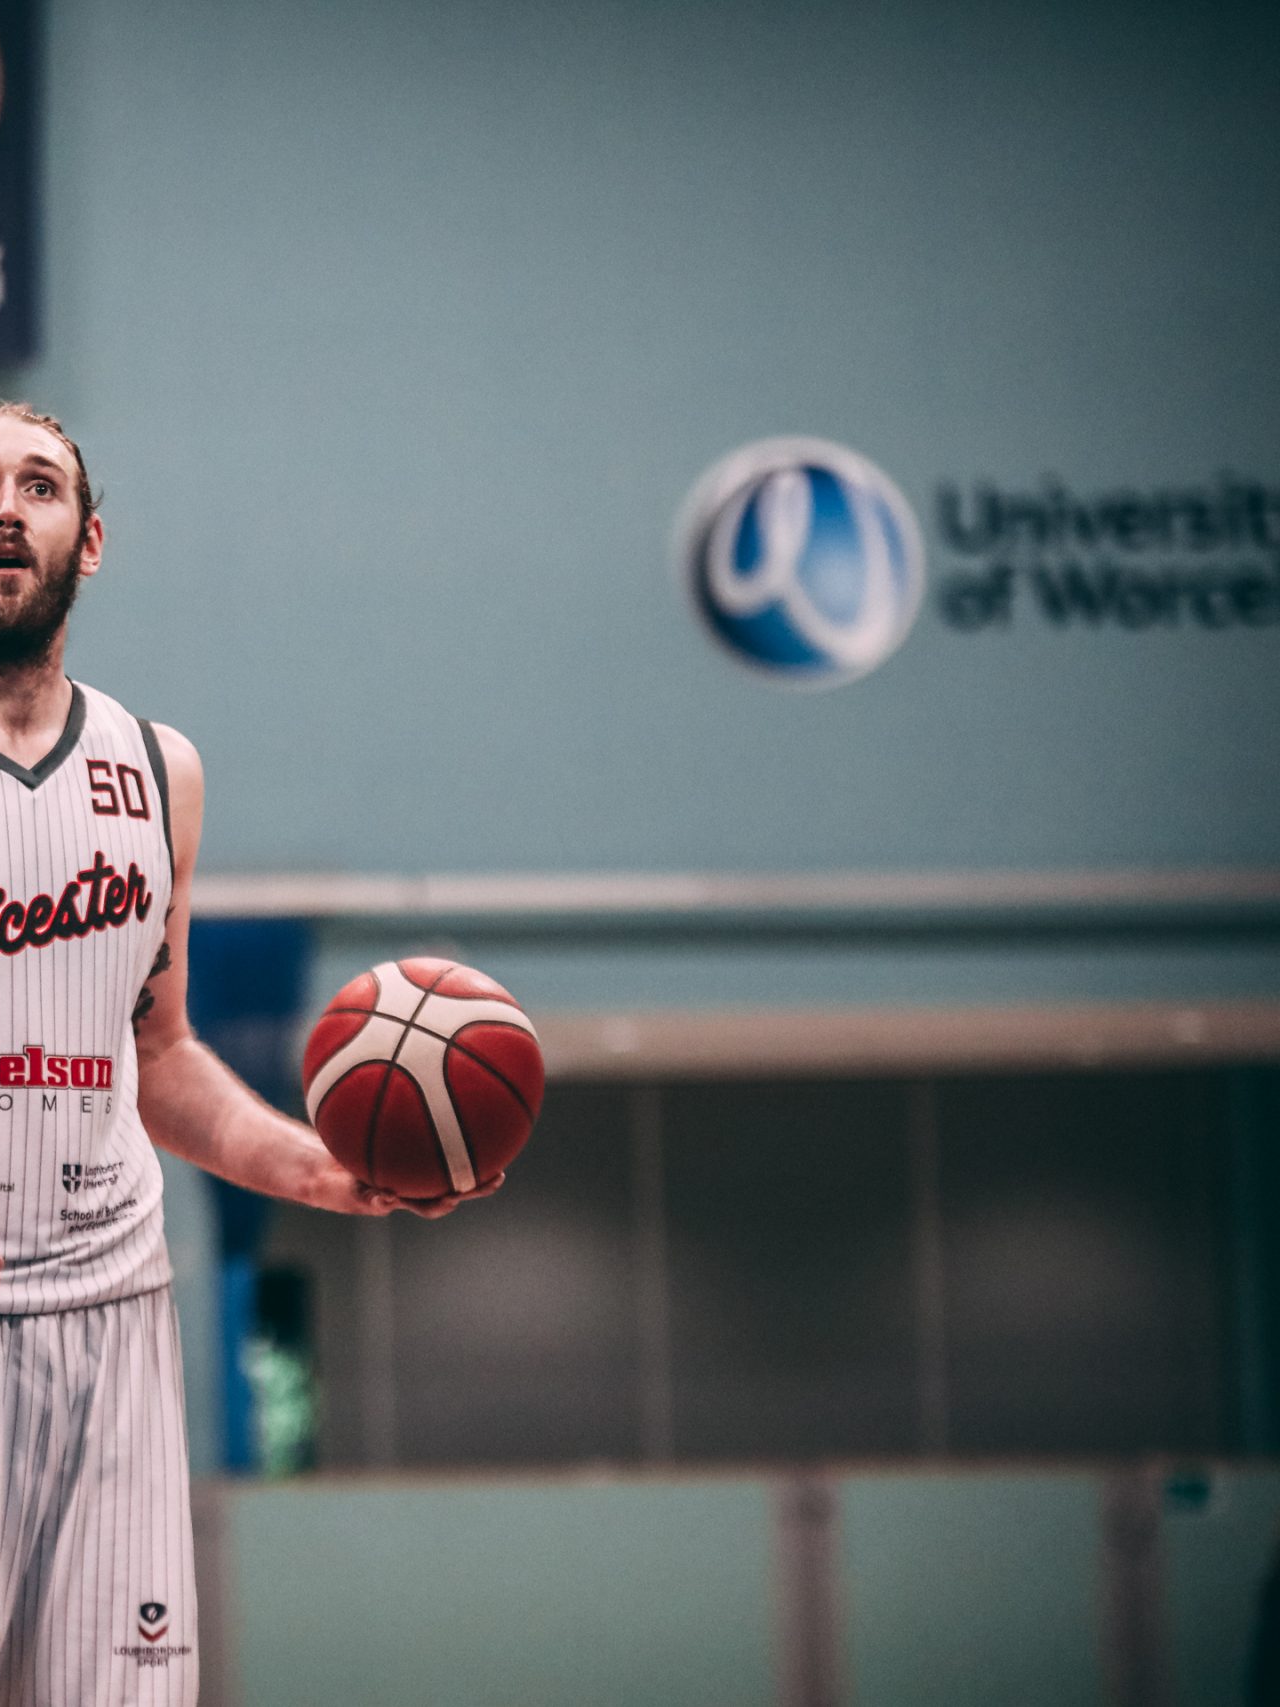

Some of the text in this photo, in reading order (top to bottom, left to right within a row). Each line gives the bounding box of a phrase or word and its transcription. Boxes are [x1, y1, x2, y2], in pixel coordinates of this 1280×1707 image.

[935, 470, 1280, 553] Universit
[1028, 563, 1280, 632] Worce
[86, 759, 150, 821] 50
[60, 1209, 94, 1221] School
